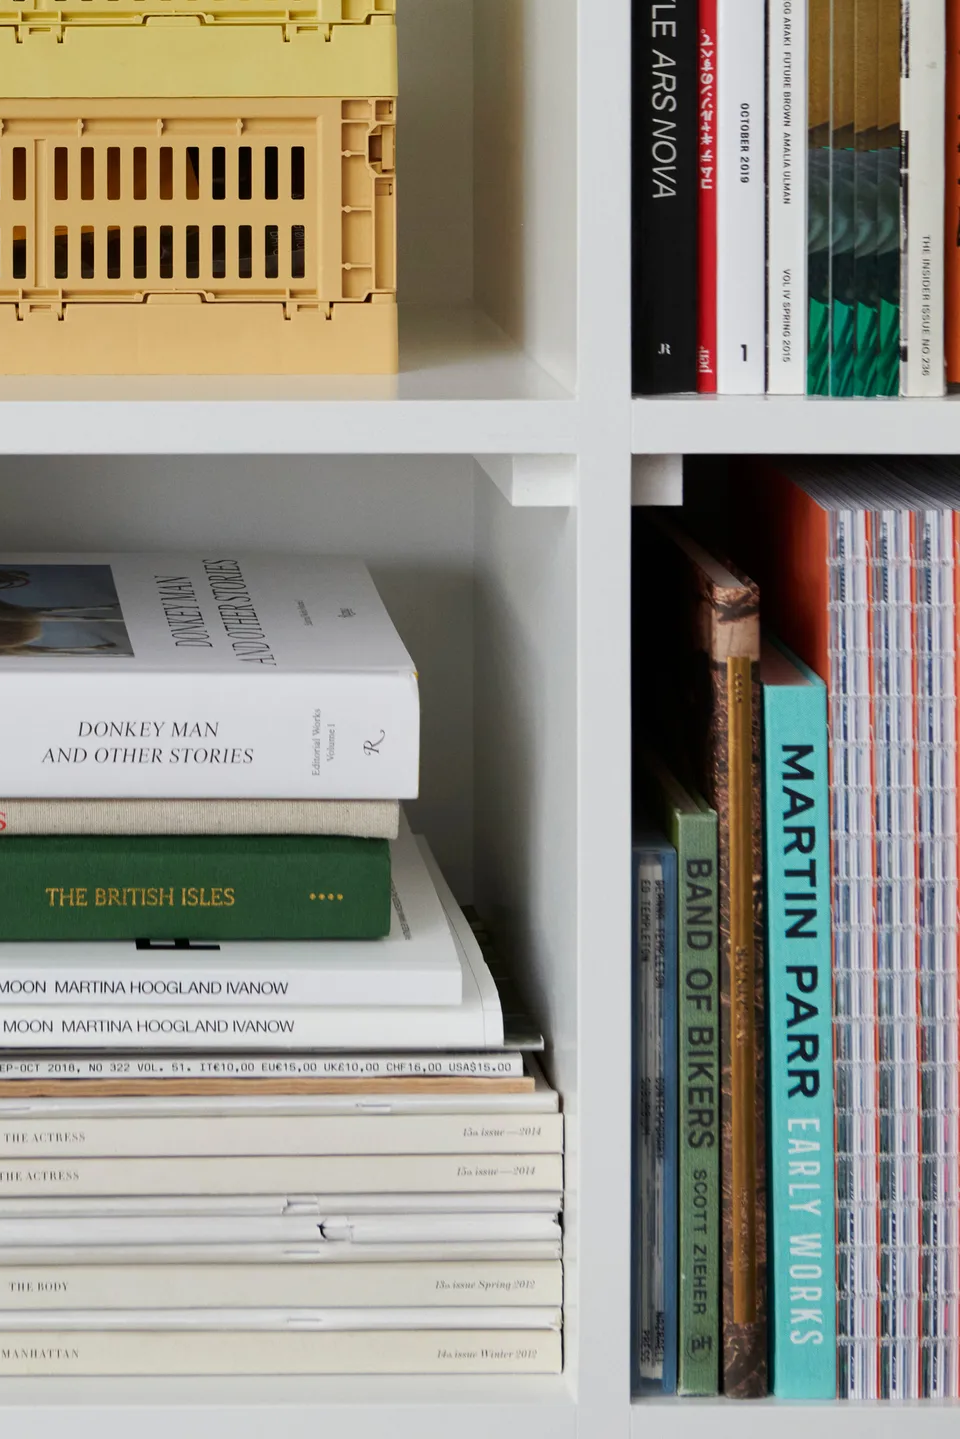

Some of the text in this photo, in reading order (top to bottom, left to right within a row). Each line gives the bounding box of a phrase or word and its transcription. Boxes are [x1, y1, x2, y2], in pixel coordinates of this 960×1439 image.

[651, 49, 677, 112] ARS
[652, 119, 677, 198] NOVA
[740, 103, 750, 184] OCTOBER 2019
[42, 748, 254, 764] AND OTHER STORIES
[78, 721, 219, 738] DONKEY MAN
[46, 887, 236, 907] THE BRITISH ISLES
[55, 981, 126, 994] MARTINA
[130, 981, 223, 994] HOOGLAND
[226, 981, 289, 994] IVANOW
[685, 859, 714, 1149] BAND OF BIKERS
[781, 744, 823, 1345] MARTIN PARR EARLY WORKS
[692, 1169, 707, 1315] SCOTT ZIEHER
